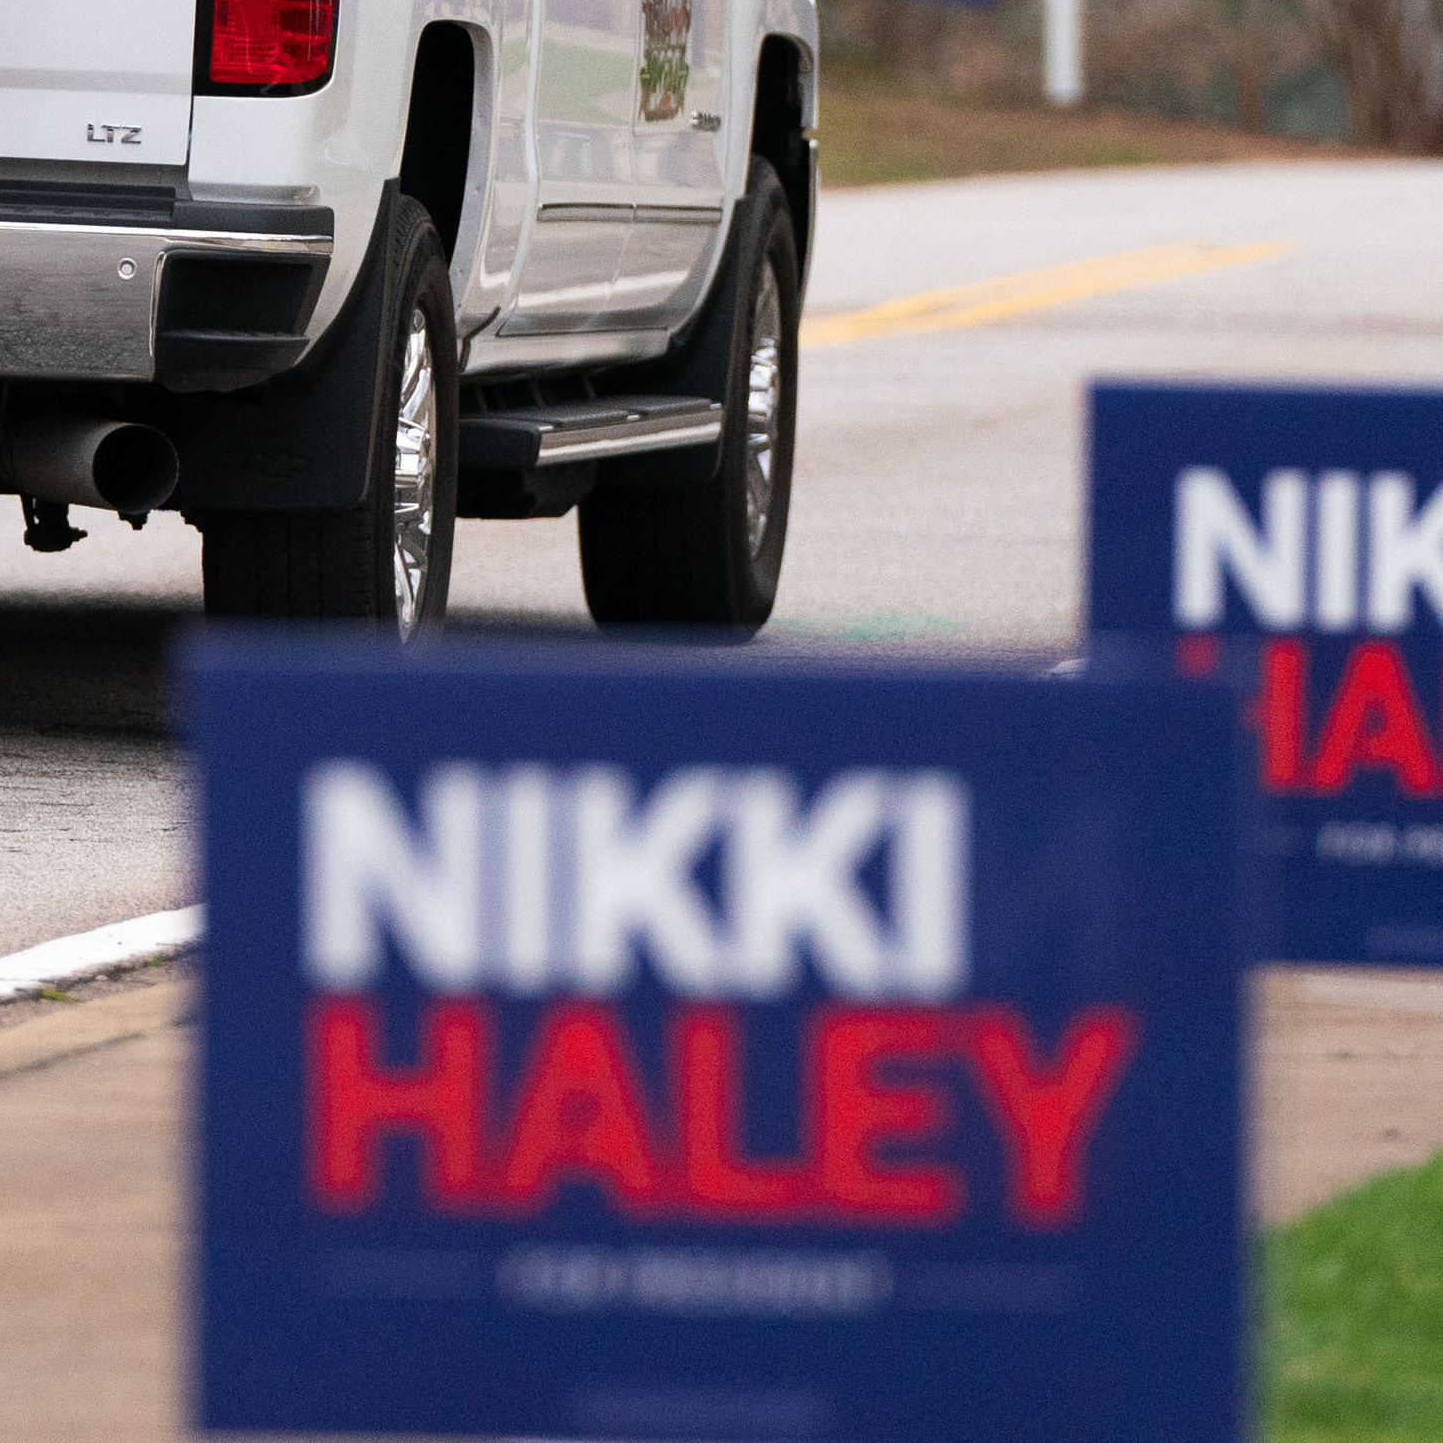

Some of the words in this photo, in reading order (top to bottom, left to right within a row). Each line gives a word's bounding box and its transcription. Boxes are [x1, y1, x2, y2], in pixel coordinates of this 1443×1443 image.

[86, 122, 143, 145] LTZ
[1172, 464, 1443, 635] NIK
[304, 758, 968, 999] NIKKI
[306, 995, 1142, 1231] HALEY
